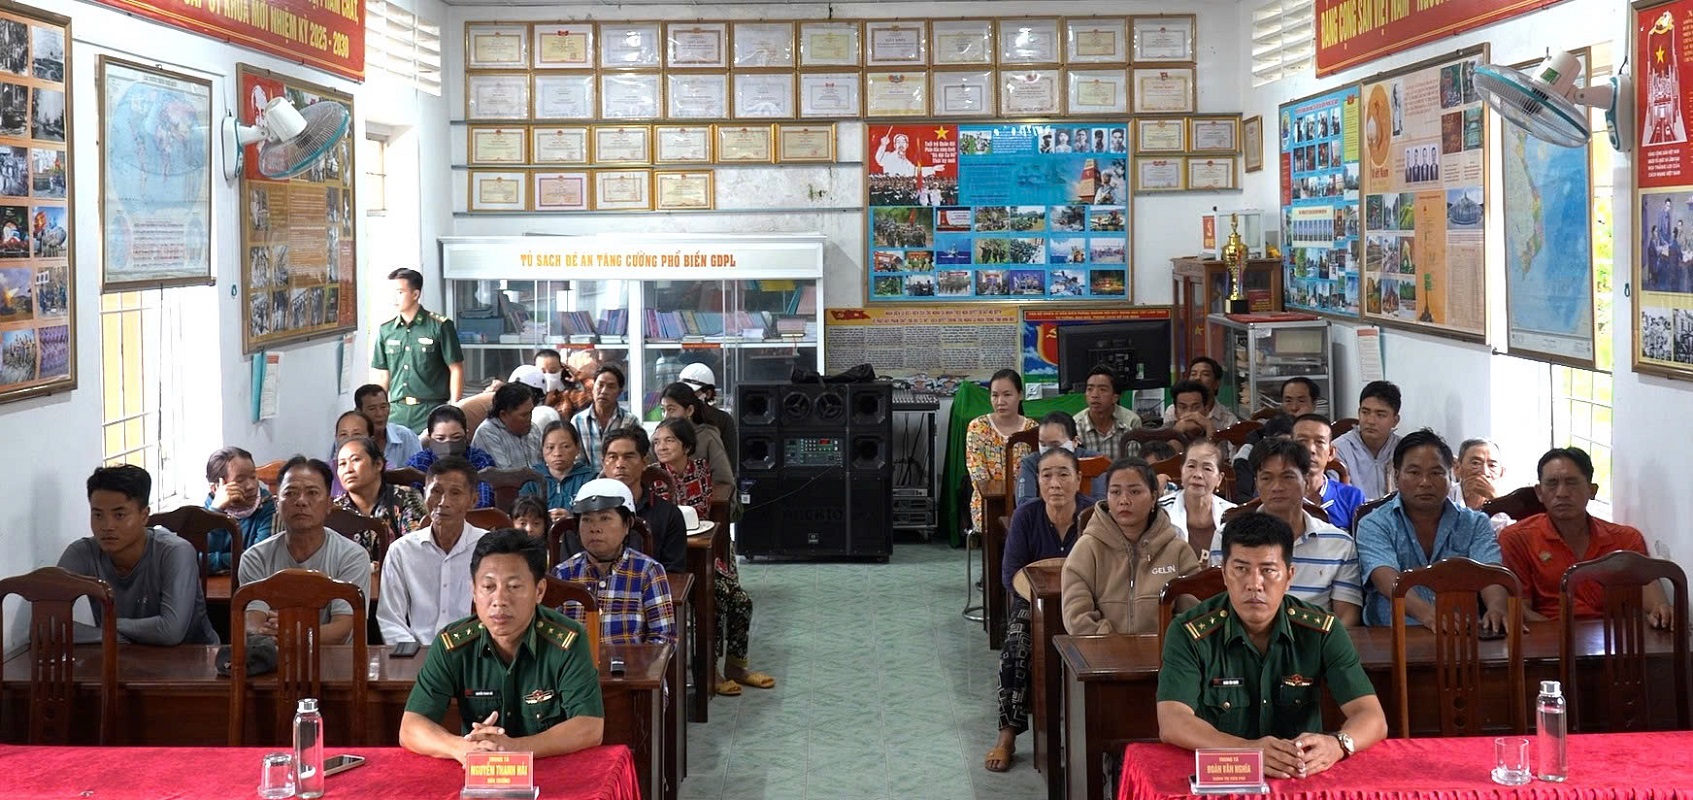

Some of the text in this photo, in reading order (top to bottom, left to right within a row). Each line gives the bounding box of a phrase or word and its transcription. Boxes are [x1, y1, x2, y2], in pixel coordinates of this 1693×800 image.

[270, 6, 297, 43] NHIỆM
[298, 13, 308, 44] KỲ
[309, 22, 327, 51] 2025
[332, 31, 349, 59] 2030
[661, 249, 681, 267] PHỔ
[683, 250, 707, 267] BIẾN
[710, 254, 736, 267] GDPL
